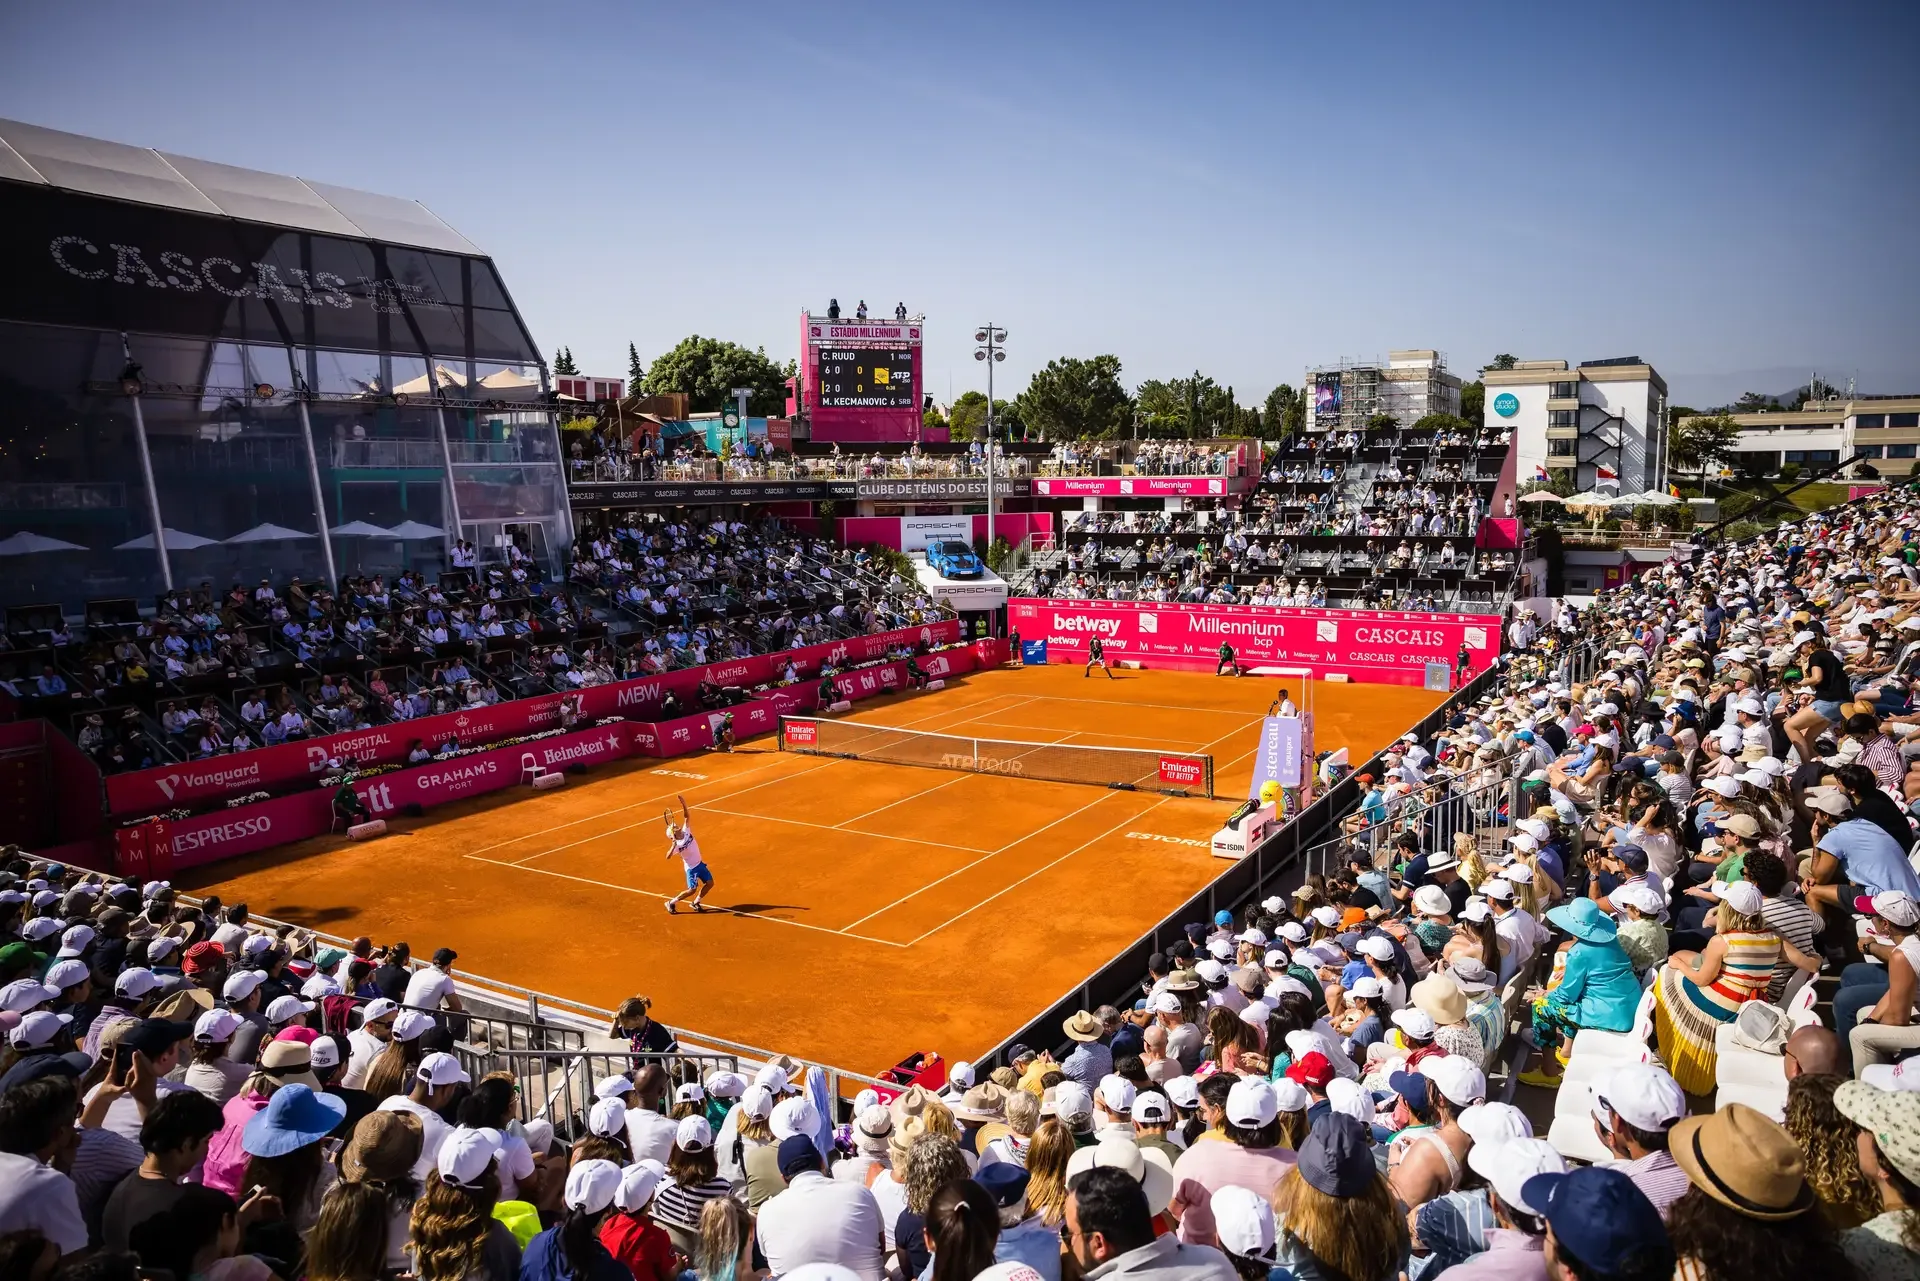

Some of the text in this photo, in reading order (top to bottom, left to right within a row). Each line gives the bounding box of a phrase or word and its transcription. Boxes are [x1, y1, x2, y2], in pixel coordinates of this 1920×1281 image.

[50, 235, 352, 308] CASCAIS
[357, 276, 422, 292] The Charm
[366, 290, 444, 306] of the Atlantic
[370, 302, 405, 314] Coast
[860, 327, 901, 338] MILLENNIUM
[825, 366, 862, 374] 6 0 0
[825, 384, 862, 392] 2 0 0
[858, 481, 1012, 495] CLUBE DE TÉNIS DO ESTRIL
[1065, 480, 1104, 489] Millennium
[1150, 480, 1192, 489] Millennium
[1054, 613, 1121, 636] betway
[1188, 613, 1284, 637] Millennium
[1048, 635, 1080, 646] betway
[1100, 638, 1127, 649] etway
[1254, 636, 1273, 648] bcp
[1355, 628, 1444, 646] CASCAIS
[1139, 641, 1148, 651] M
[1184, 643, 1193, 653] M
[1277, 649, 1287, 659] M
[1326, 651, 1448, 664] M CASCAIS CASCAIS
[717, 666, 748, 679] ANTHEA
[880, 668, 897, 682] CNN
[861, 672, 876, 689] tvi
[618, 683, 660, 707] MBW
[530, 702, 554, 712] TURISMO
[528, 710, 560, 723] PORTUGA
[750, 709, 764, 720] ATP
[432, 724, 494, 742] VISTA ALEGRE
[672, 728, 688, 740] ATP
[787, 725, 815, 734] Emirates
[332, 733, 390, 754] HOSPITAL
[634, 734, 654, 743] ATP
[354, 748, 377, 762] LUZ
[544, 741, 604, 765] Heineken
[1266, 722, 1279, 778] stereau
[942, 753, 1023, 774] ATP TOUR
[1162, 761, 1200, 774] Emirates
[183, 762, 260, 788] Vanguard
[417, 761, 497, 788] GRAHAM'S
[1176, 772, 1194, 780] BETTER
[226, 777, 260, 788] Properties
[449, 780, 472, 791] PORT
[131, 830, 139, 840] 4
[156, 825, 163, 834] 3
[1125, 832, 1211, 848] ESTORIL
[130, 849, 143, 862] M
[155, 843, 168, 855] M
